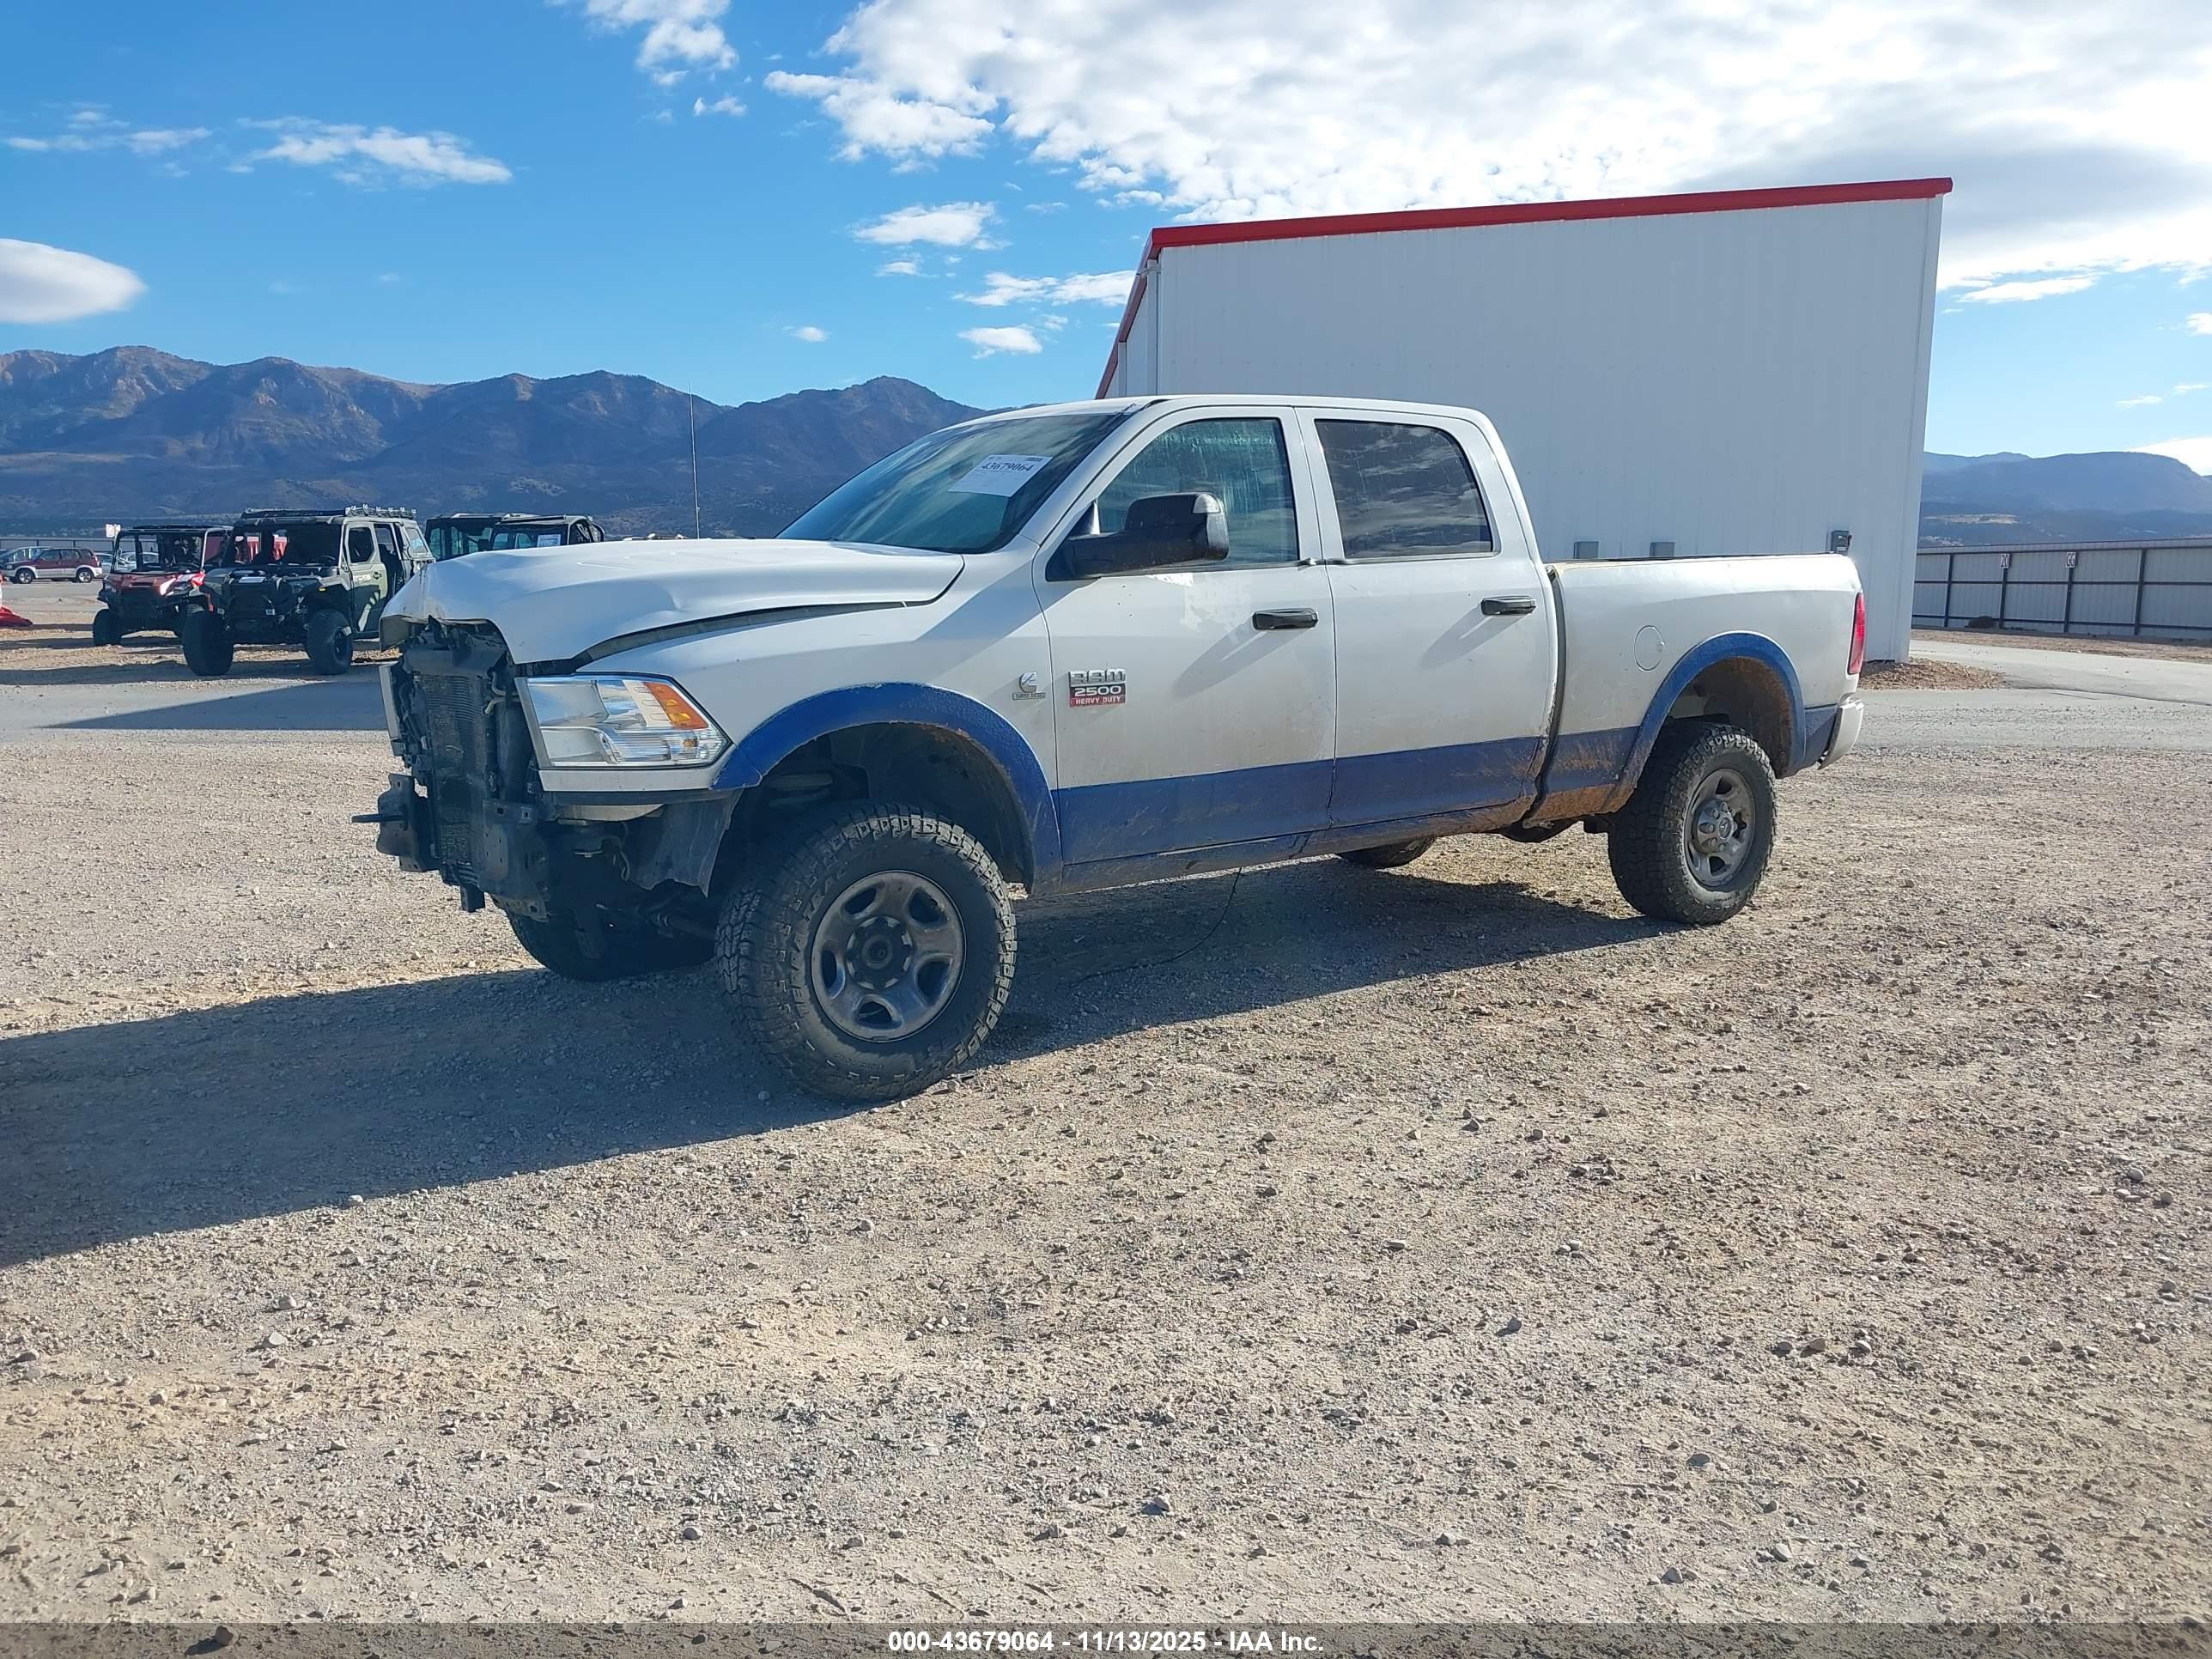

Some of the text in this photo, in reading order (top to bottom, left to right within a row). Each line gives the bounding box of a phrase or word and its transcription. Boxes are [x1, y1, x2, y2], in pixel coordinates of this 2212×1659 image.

[2000, 555, 2008, 568] 20
[1069, 669, 1127, 684] RAM
[1074, 686, 1121, 697] 2500
